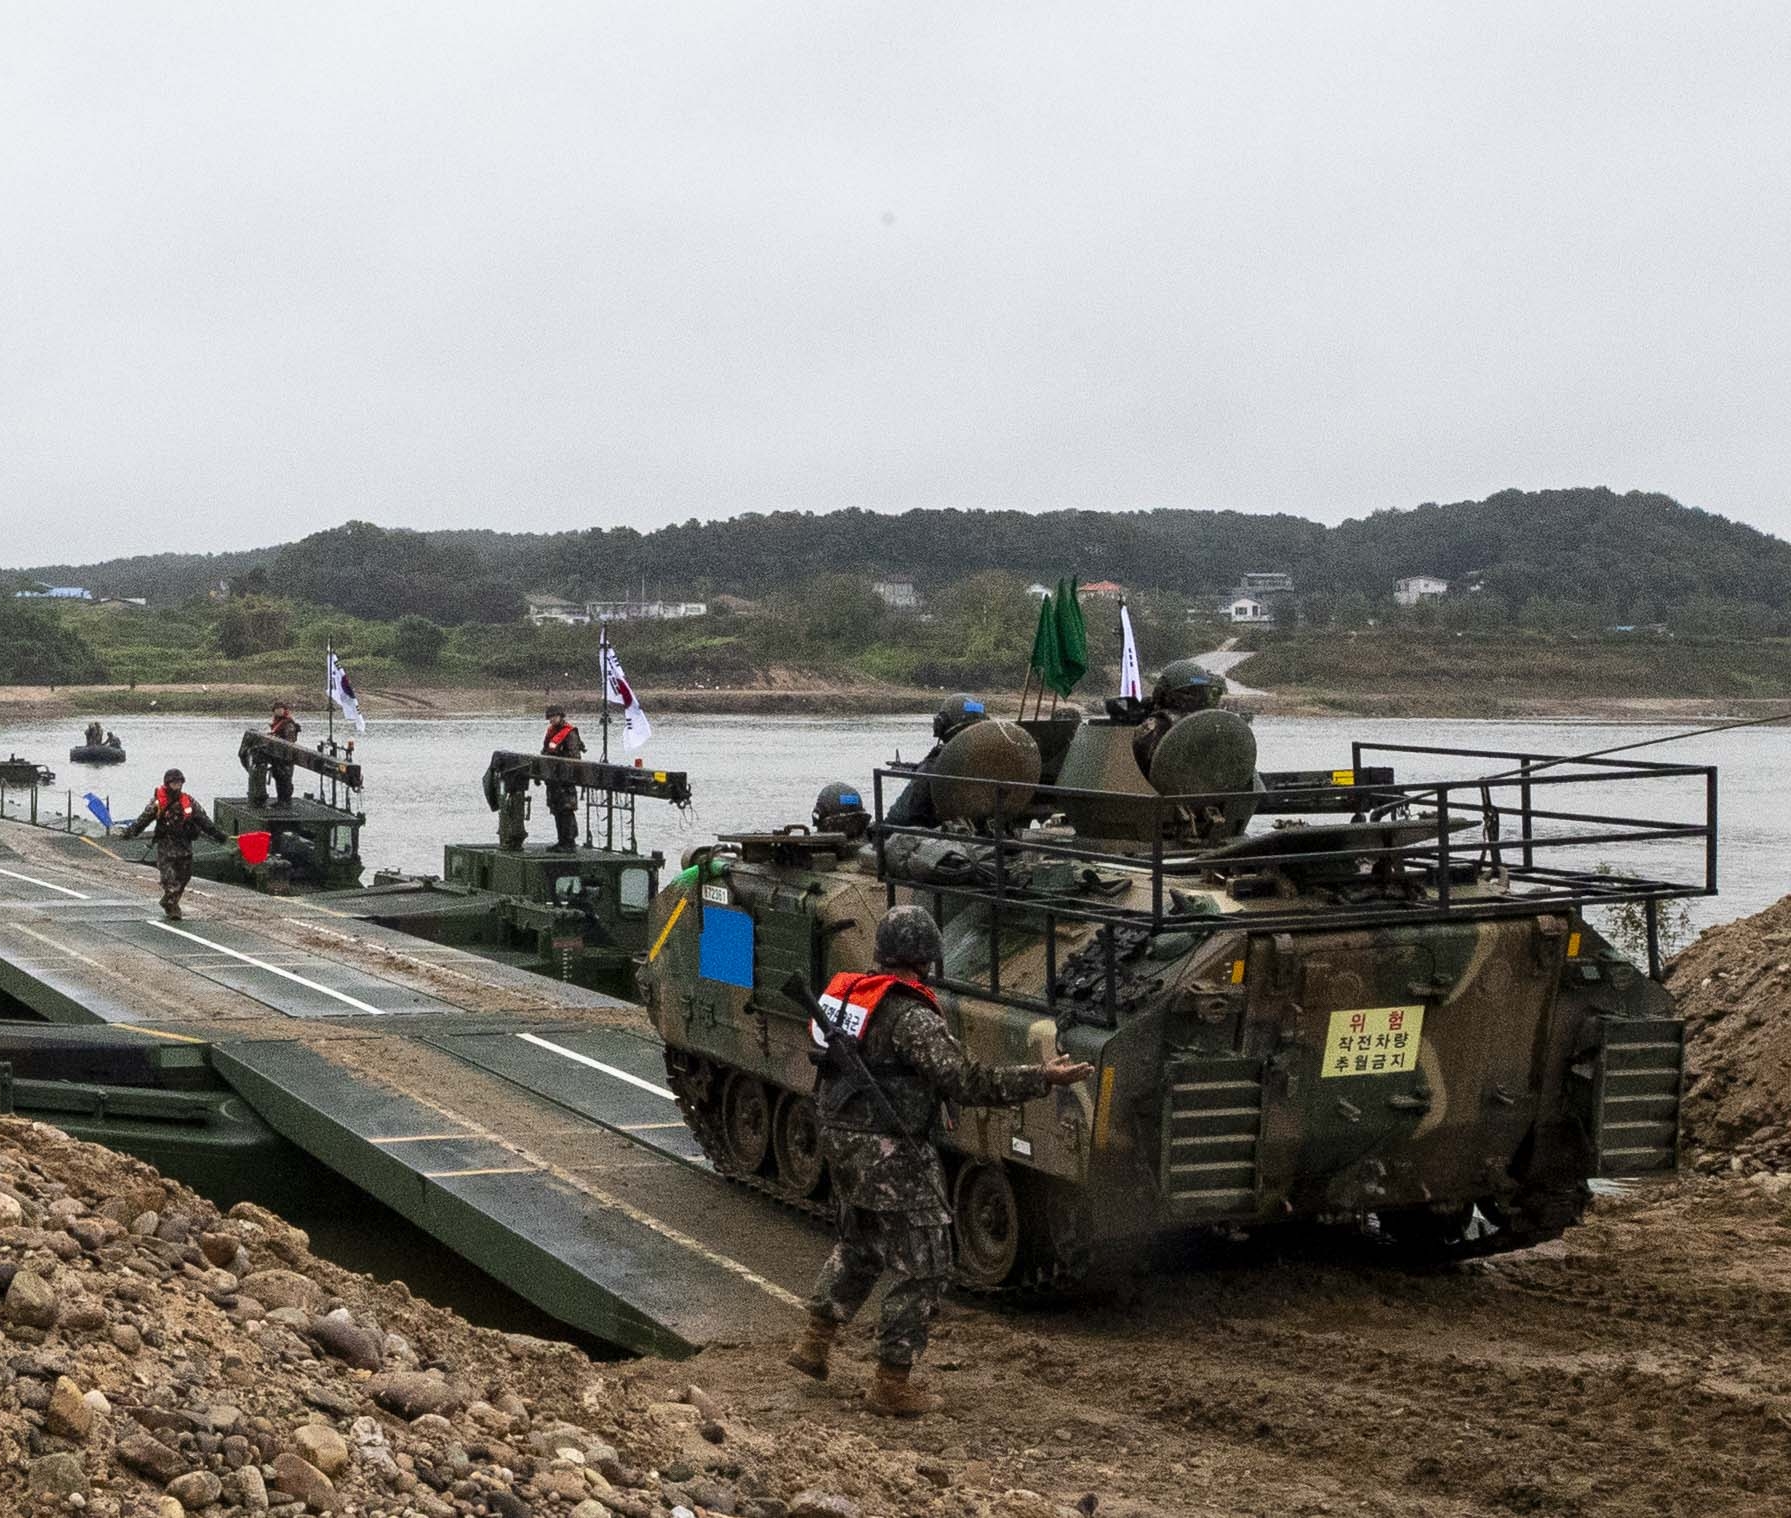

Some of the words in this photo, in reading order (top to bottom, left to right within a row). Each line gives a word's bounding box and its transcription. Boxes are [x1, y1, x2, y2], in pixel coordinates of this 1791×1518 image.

[1349, 1010, 1404, 1033] 위험
[1338, 1031, 1409, 1052] 작전차량
[1334, 1052, 1405, 1072] 추월금지
